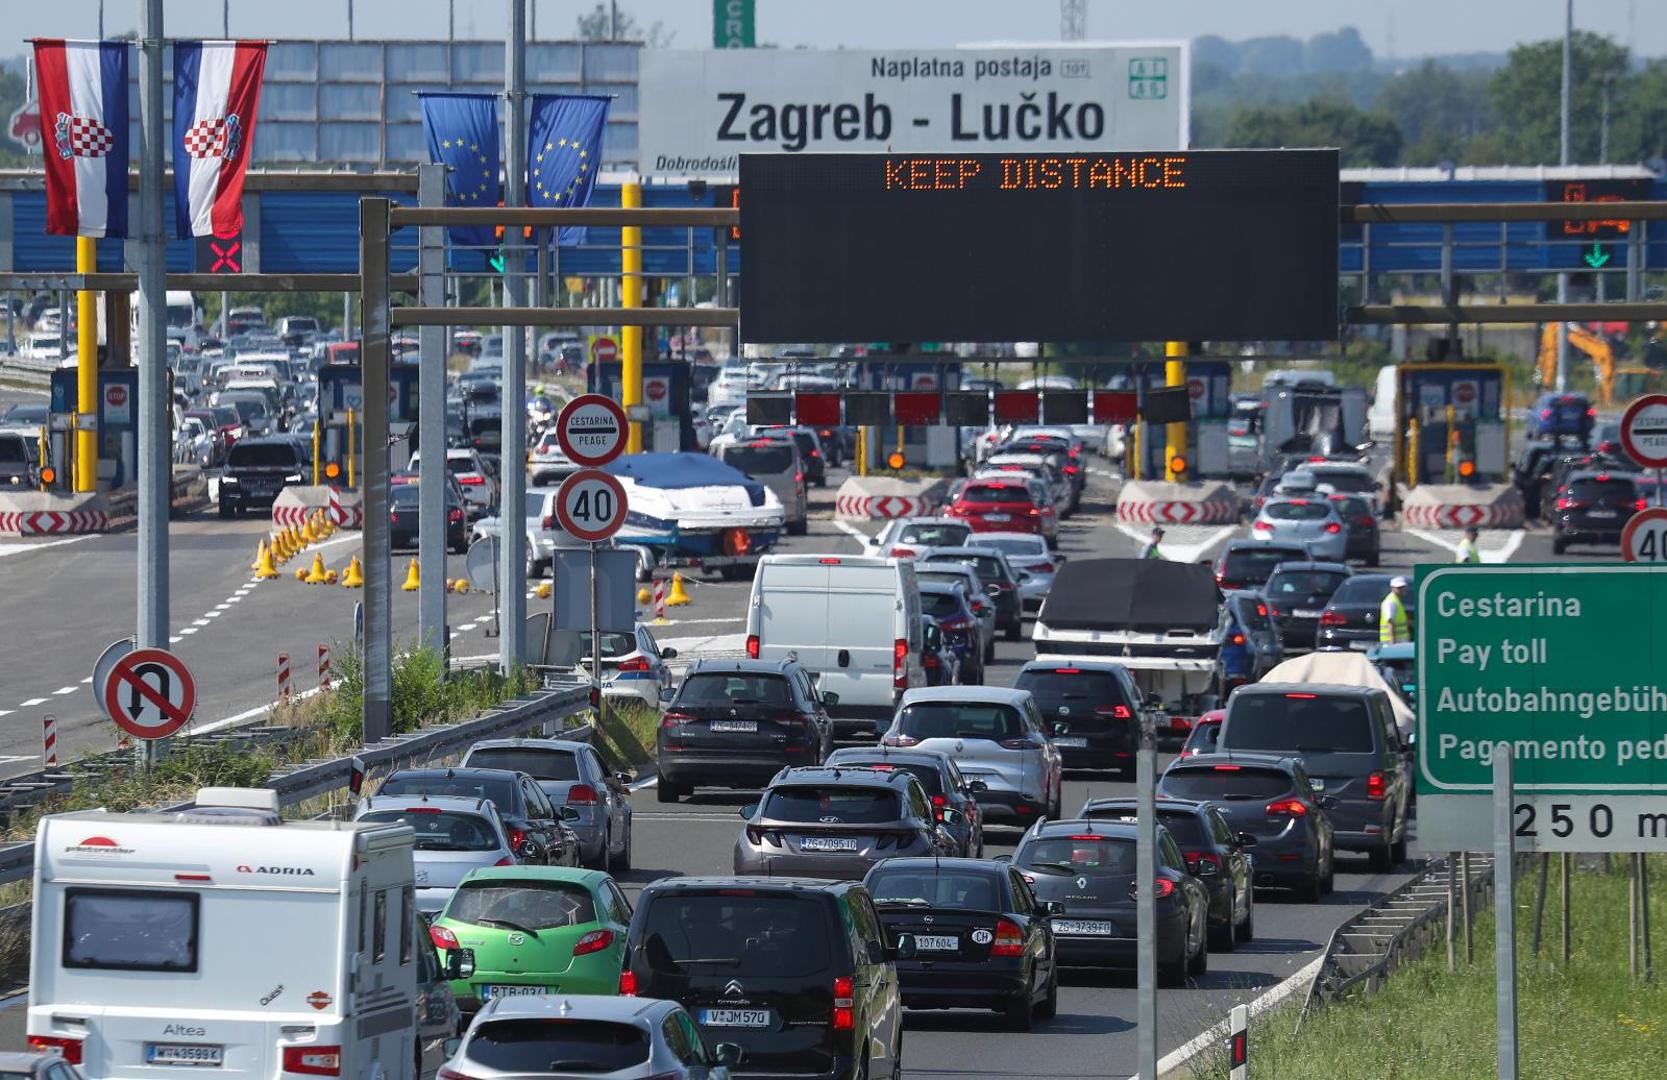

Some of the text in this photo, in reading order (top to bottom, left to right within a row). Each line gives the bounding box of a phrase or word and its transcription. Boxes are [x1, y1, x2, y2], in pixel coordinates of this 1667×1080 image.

[872, 57, 964, 82] Naplatna
[975, 57, 1052, 81] postaja
[717, 91, 1104, 152] Zagreb - Lučko
[656, 154, 737, 171] Dobrodošli
[886, 157, 1186, 189] KEEP DISTANCE
[570, 416, 614, 426] CESTARINA
[579, 435, 608, 446] PEAGE
[573, 489, 612, 522] 40
[1437, 591, 1581, 618] Cestarina
[1437, 638, 1547, 671] Pay toll
[1437, 685, 1667, 719] Autobahngebüh
[1616, 733, 1667, 766] ped
[1514, 803, 1613, 838] 250
[256, 866, 315, 876] ADRIA
[976, 929, 989, 942] CH
[163, 1024, 206, 1037] Altea
